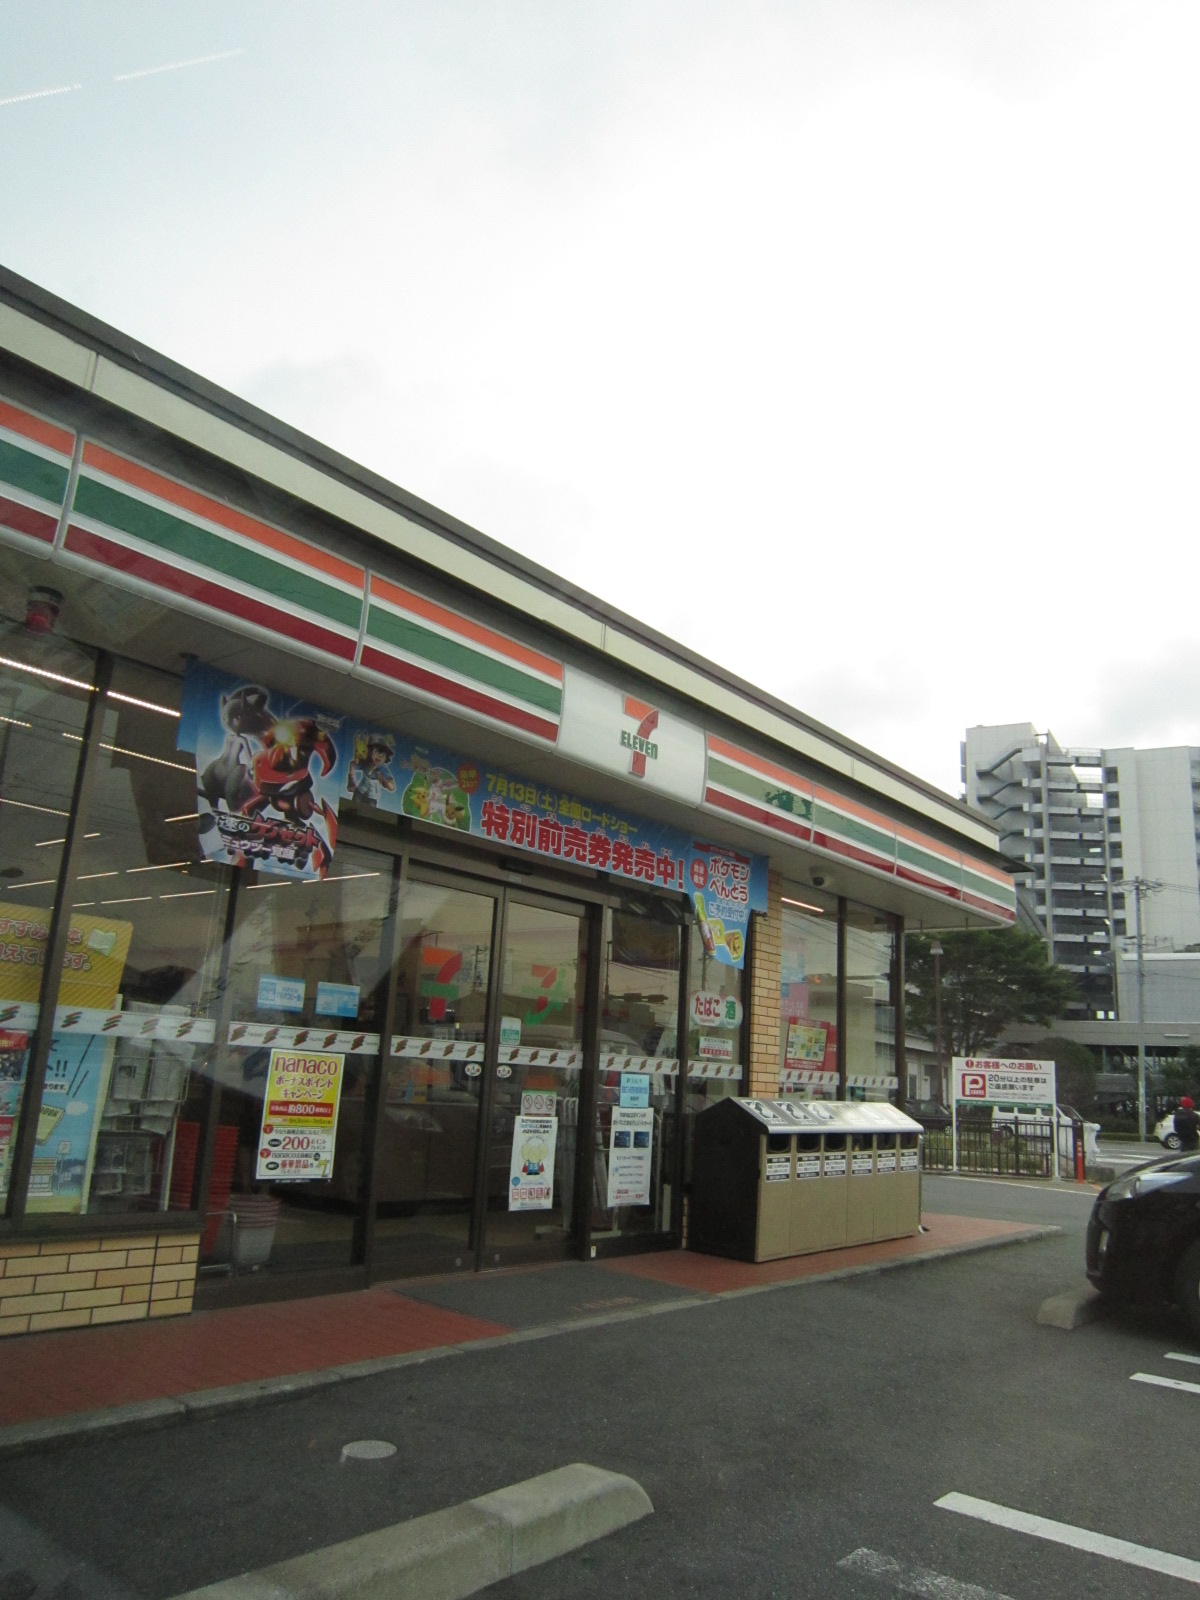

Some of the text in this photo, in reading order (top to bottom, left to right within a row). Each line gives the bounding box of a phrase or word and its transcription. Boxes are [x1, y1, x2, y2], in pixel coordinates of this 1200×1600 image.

[620, 730, 658, 760] ELEVEN
[709, 857, 750, 881] ポケモン
[694, 995, 721, 1018] たばこ
[725, 1000, 737, 1021] 酒
[274, 1056, 338, 1076] nanaco
[975, 1060, 1042, 1071] お客様へのお願い
[275, 1074, 334, 1089] ボーナスポイント
[282, 1088, 325, 1100] キャンペーン
[281, 1136, 311, 1151] 200
